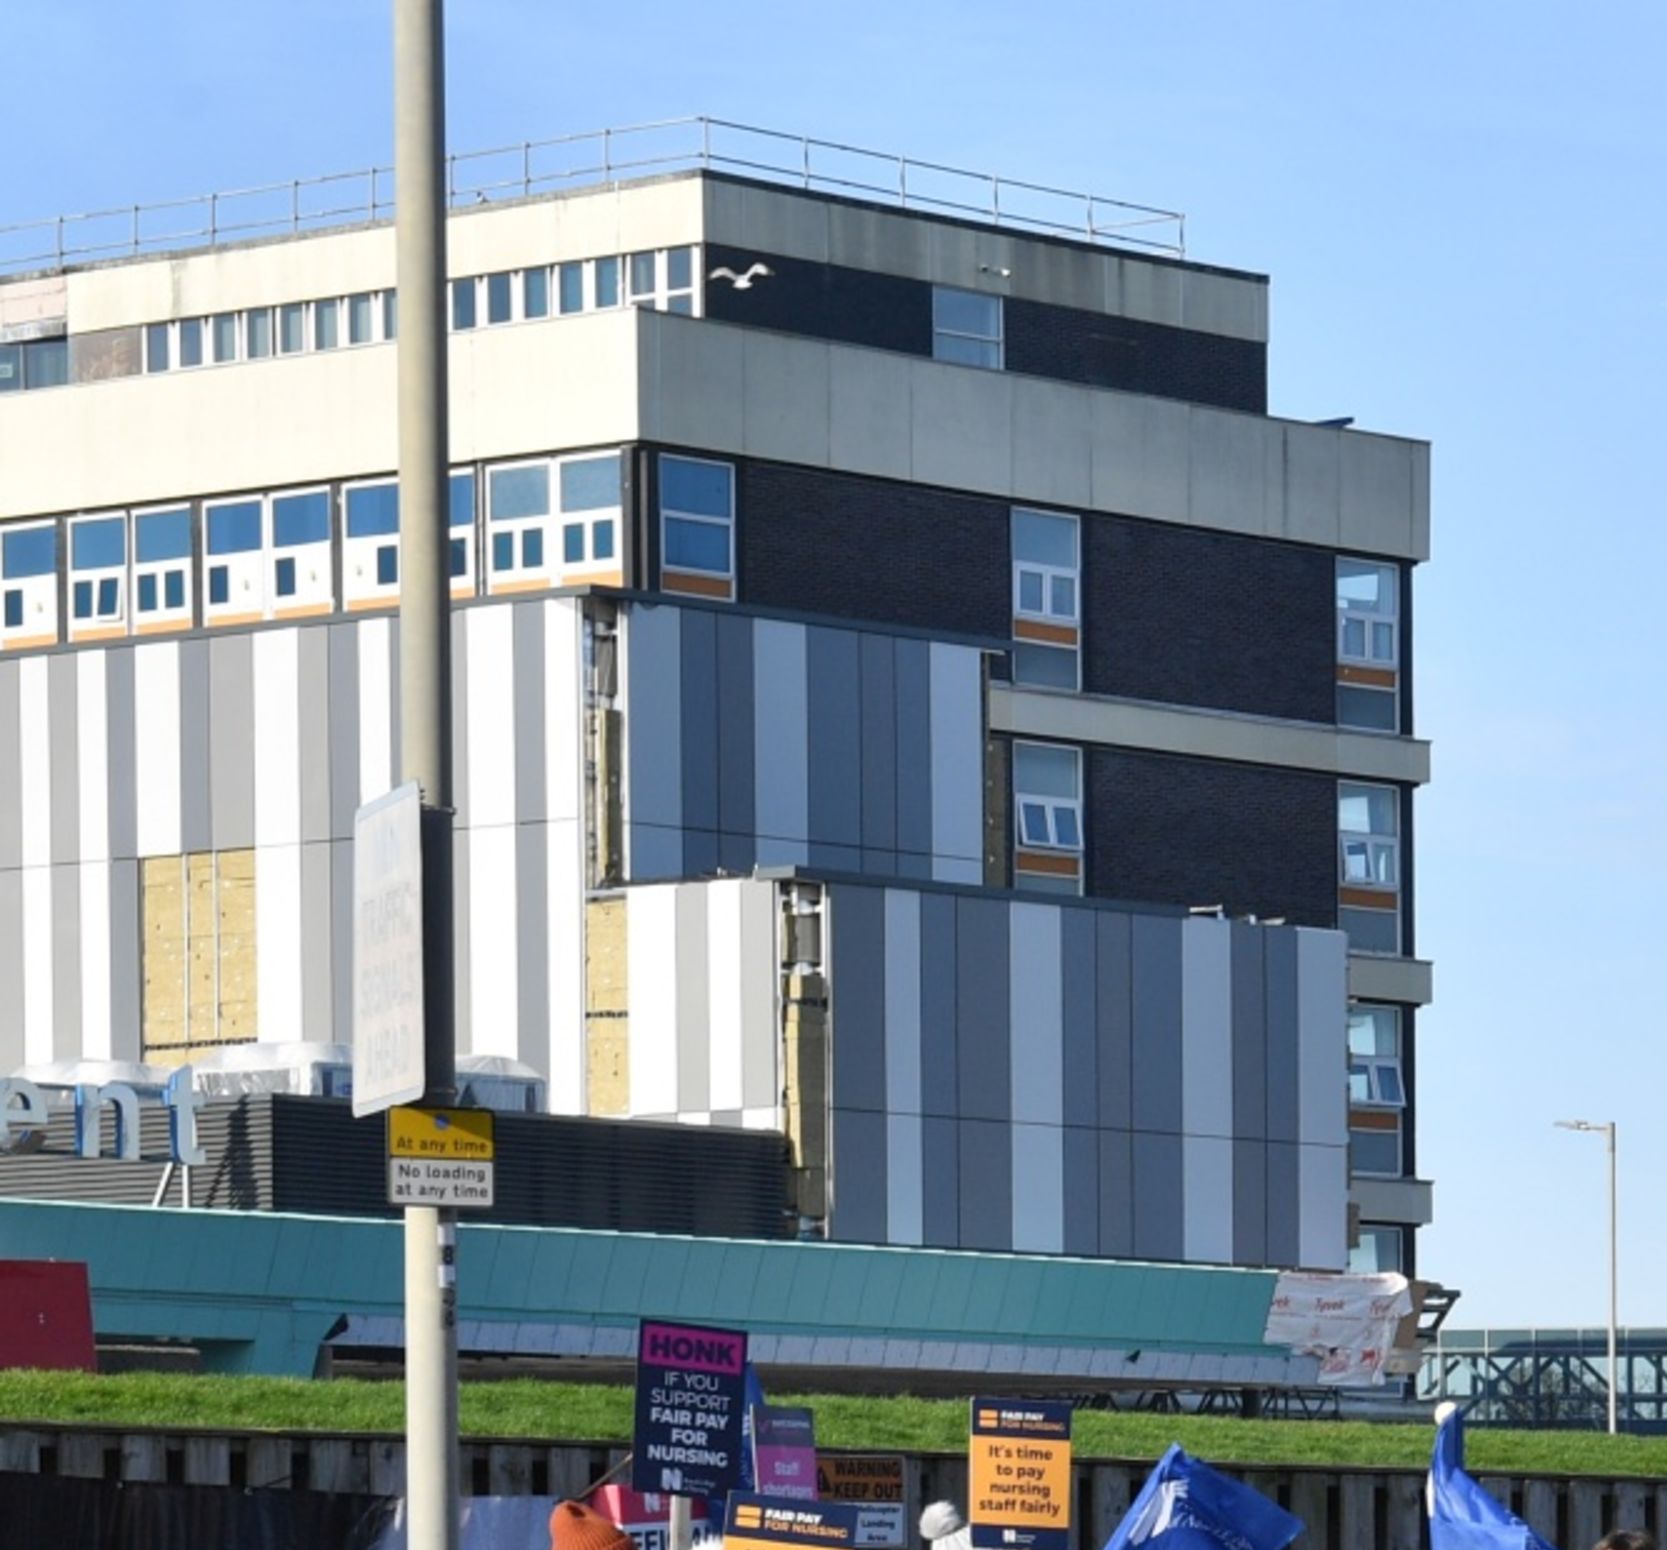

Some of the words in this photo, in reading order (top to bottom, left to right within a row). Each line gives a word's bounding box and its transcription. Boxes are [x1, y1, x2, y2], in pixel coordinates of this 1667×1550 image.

[397, 1136, 412, 1150] At
[420, 1141, 446, 1153] any
[454, 1138, 488, 1152] time
[398, 1164, 420, 1178] No
[426, 1166, 485, 1182] loading
[396, 1184, 411, 1195] at
[419, 1186, 446, 1199] any
[453, 1184, 488, 1197] time
[650, 1334, 735, 1368] HONK
[665, 1371, 681, 1385] IF
[684, 1374, 719, 1391] YOU
[651, 1388, 731, 1411] SUPPORT
[650, 1408, 692, 1425] FAIR
[695, 1412, 729, 1430] PAY
[671, 1428, 708, 1446] FOR
[648, 1445, 728, 1467] NURSING
[989, 1445, 1013, 1457] It's
[1017, 1447, 1053, 1461] time
[997, 1464, 1012, 1475] to
[1017, 1467, 1045, 1480] pay
[990, 1481, 1051, 1499] nursing
[765, 1509, 795, 1522] FAIR
[797, 1512, 823, 1524] PAY
[980, 1499, 1016, 1512] staff
[1020, 1501, 1060, 1517] fairly
[792, 1523, 848, 1539] NURSING
